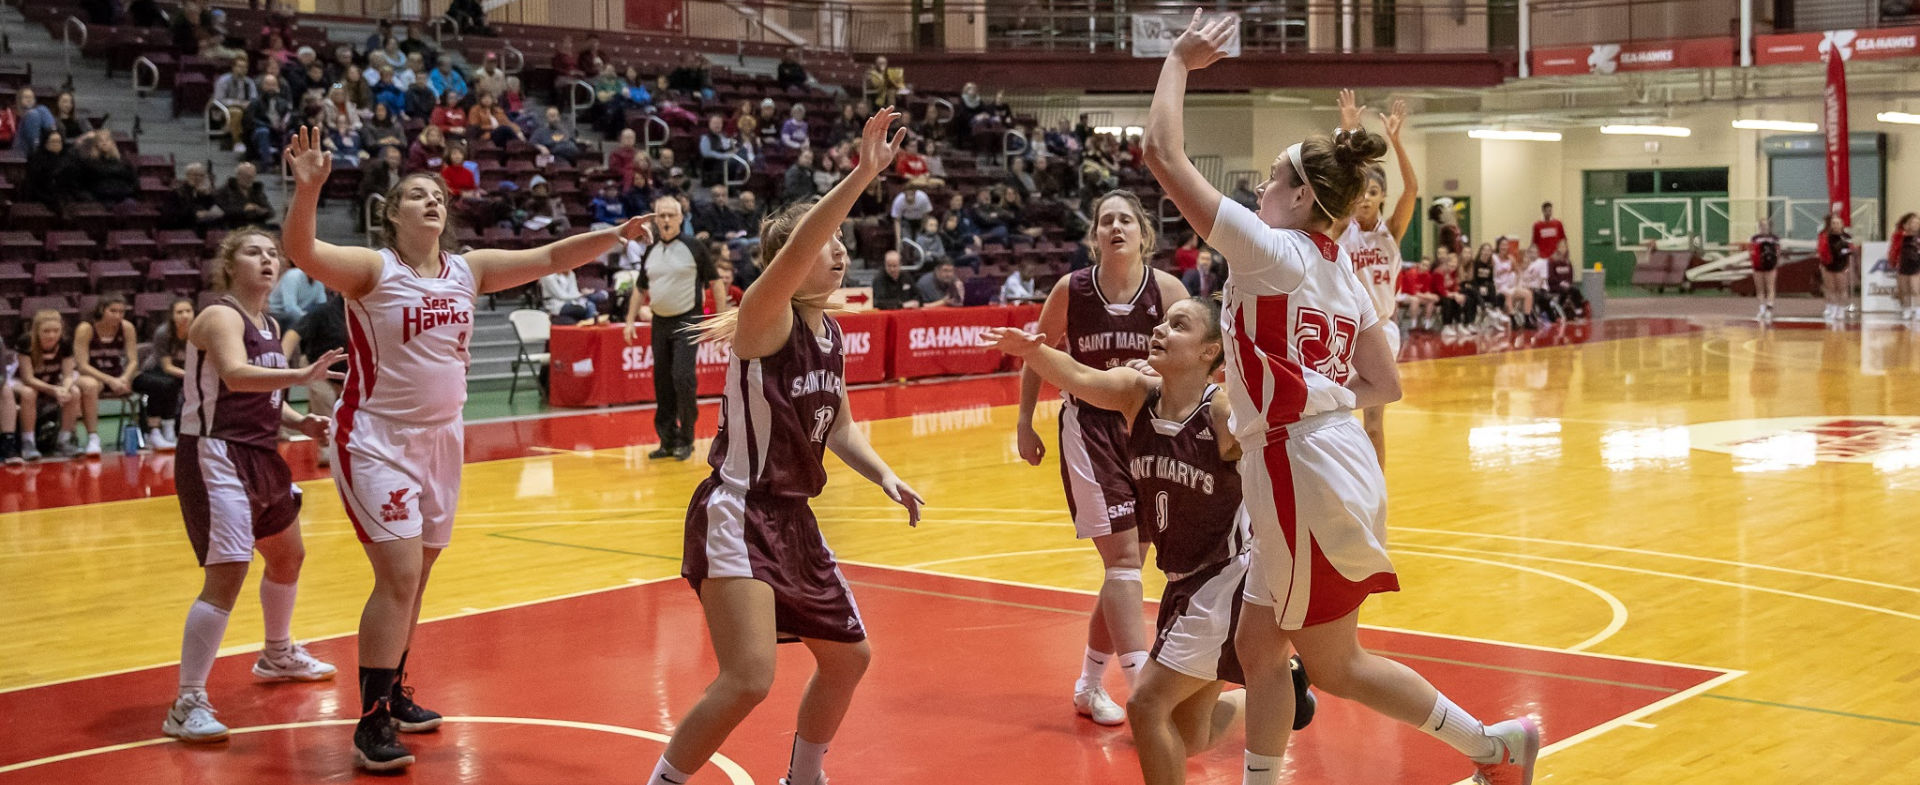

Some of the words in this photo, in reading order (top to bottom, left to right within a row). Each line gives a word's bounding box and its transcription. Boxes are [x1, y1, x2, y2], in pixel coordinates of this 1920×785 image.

[1373, 270, 1391, 285] 24
[402, 305, 469, 345] Hawks
[1078, 332, 1114, 352] SAINT
[1155, 456, 1215, 495] MARY'S
